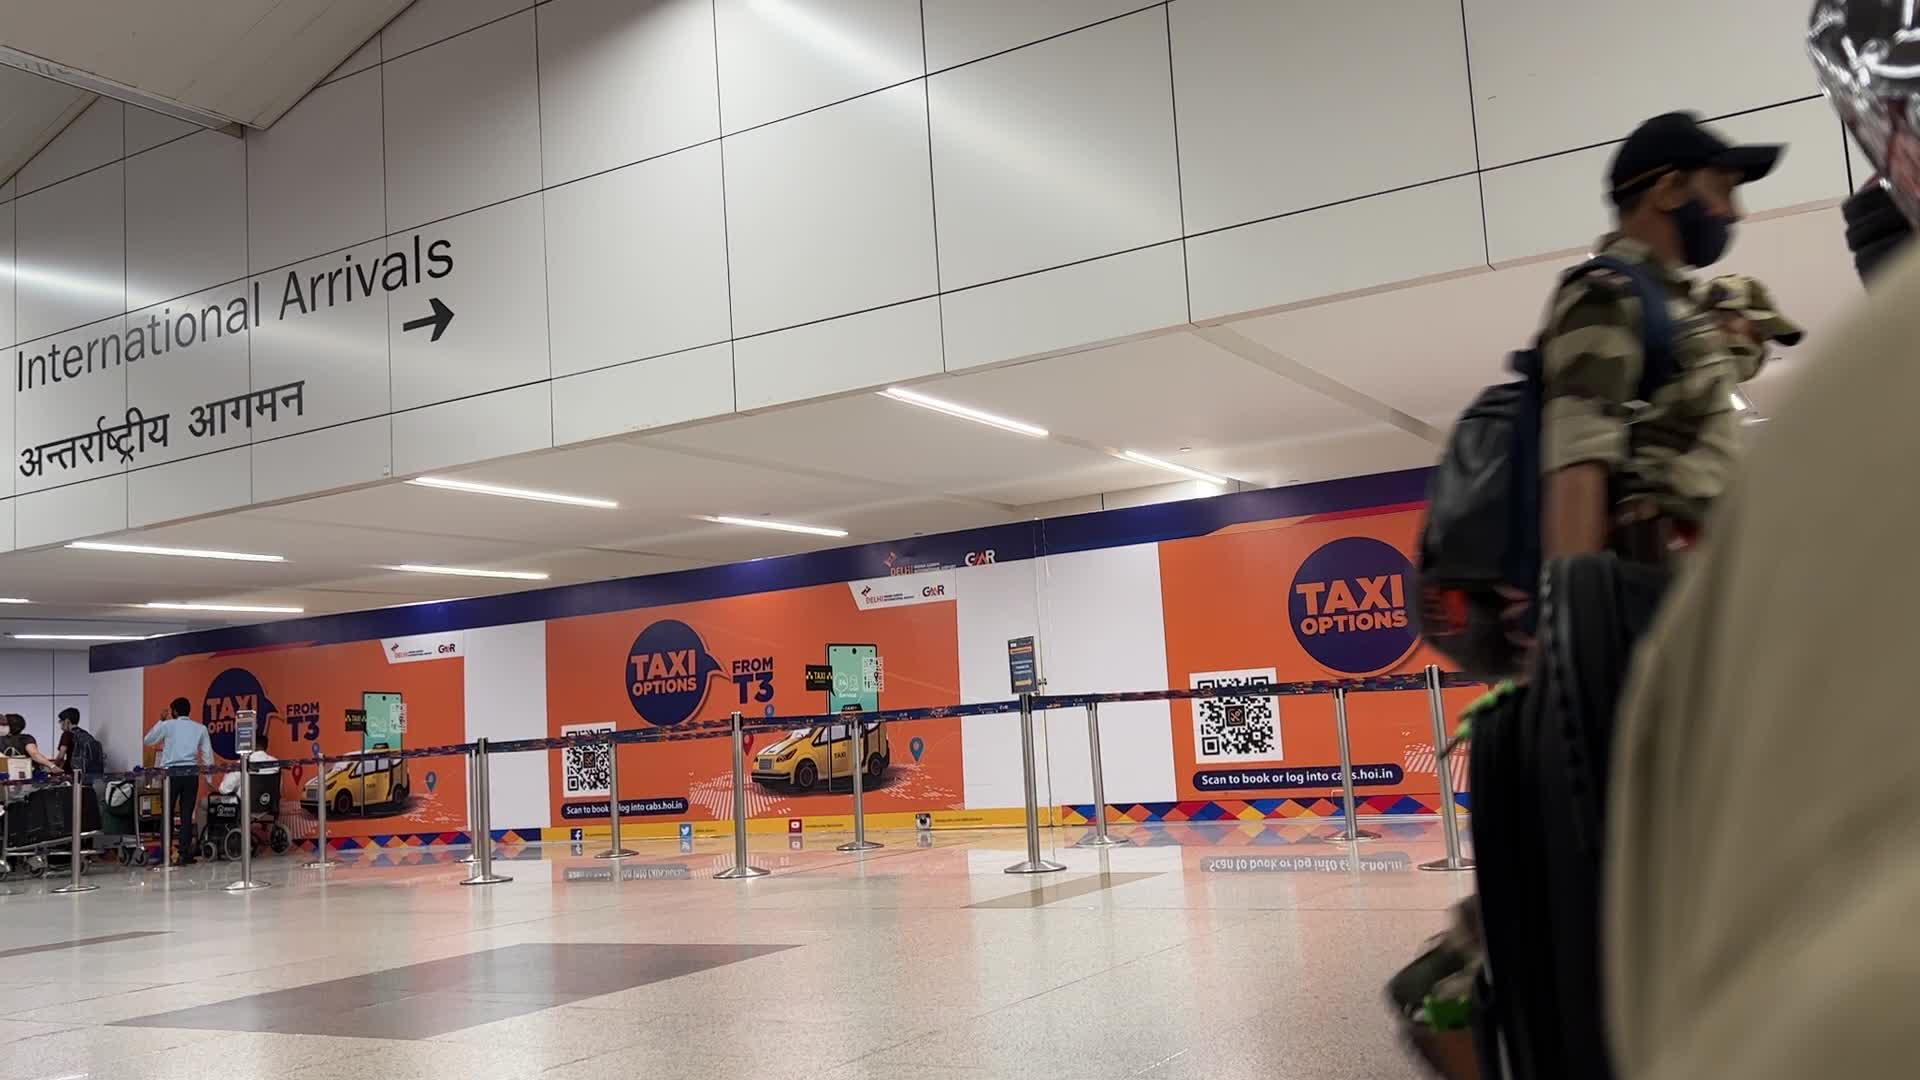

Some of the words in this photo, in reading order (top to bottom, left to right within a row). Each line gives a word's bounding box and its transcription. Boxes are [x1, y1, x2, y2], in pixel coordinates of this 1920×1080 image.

[17, 281, 260, 392] International
[279, 234, 454, 320] Arrivals
[19, 406, 170, 477] अन्तर्राष्ट्रीय
[188, 380, 305, 438] आगमन
[1296, 574, 1405, 616] TAXI
[1300, 609, 1408, 636] OPTIONS
[631, 649, 696, 682] TAXI
[732, 657, 774, 673] FROM
[814, 671, 827, 680] TAXI
[632, 677, 697, 697] OPTIONS
[733, 672, 774, 704] T3
[286, 702, 320, 716] FROM
[287, 715, 320, 741] T3
[1201, 774, 1227, 785] Scan
[1229, 775, 1240, 785] to
[1242, 771, 1270, 784] book
[1273, 774, 1283, 783] or
[1286, 771, 1304, 785] log
[1307, 772, 1329, 782] into
[1331, 769, 1393, 782] cas.hoi.in
[566, 806, 583, 815] Scan
[584, 806, 591, 814] to
[592, 805, 609, 813] book
[631, 803, 644, 811] into
